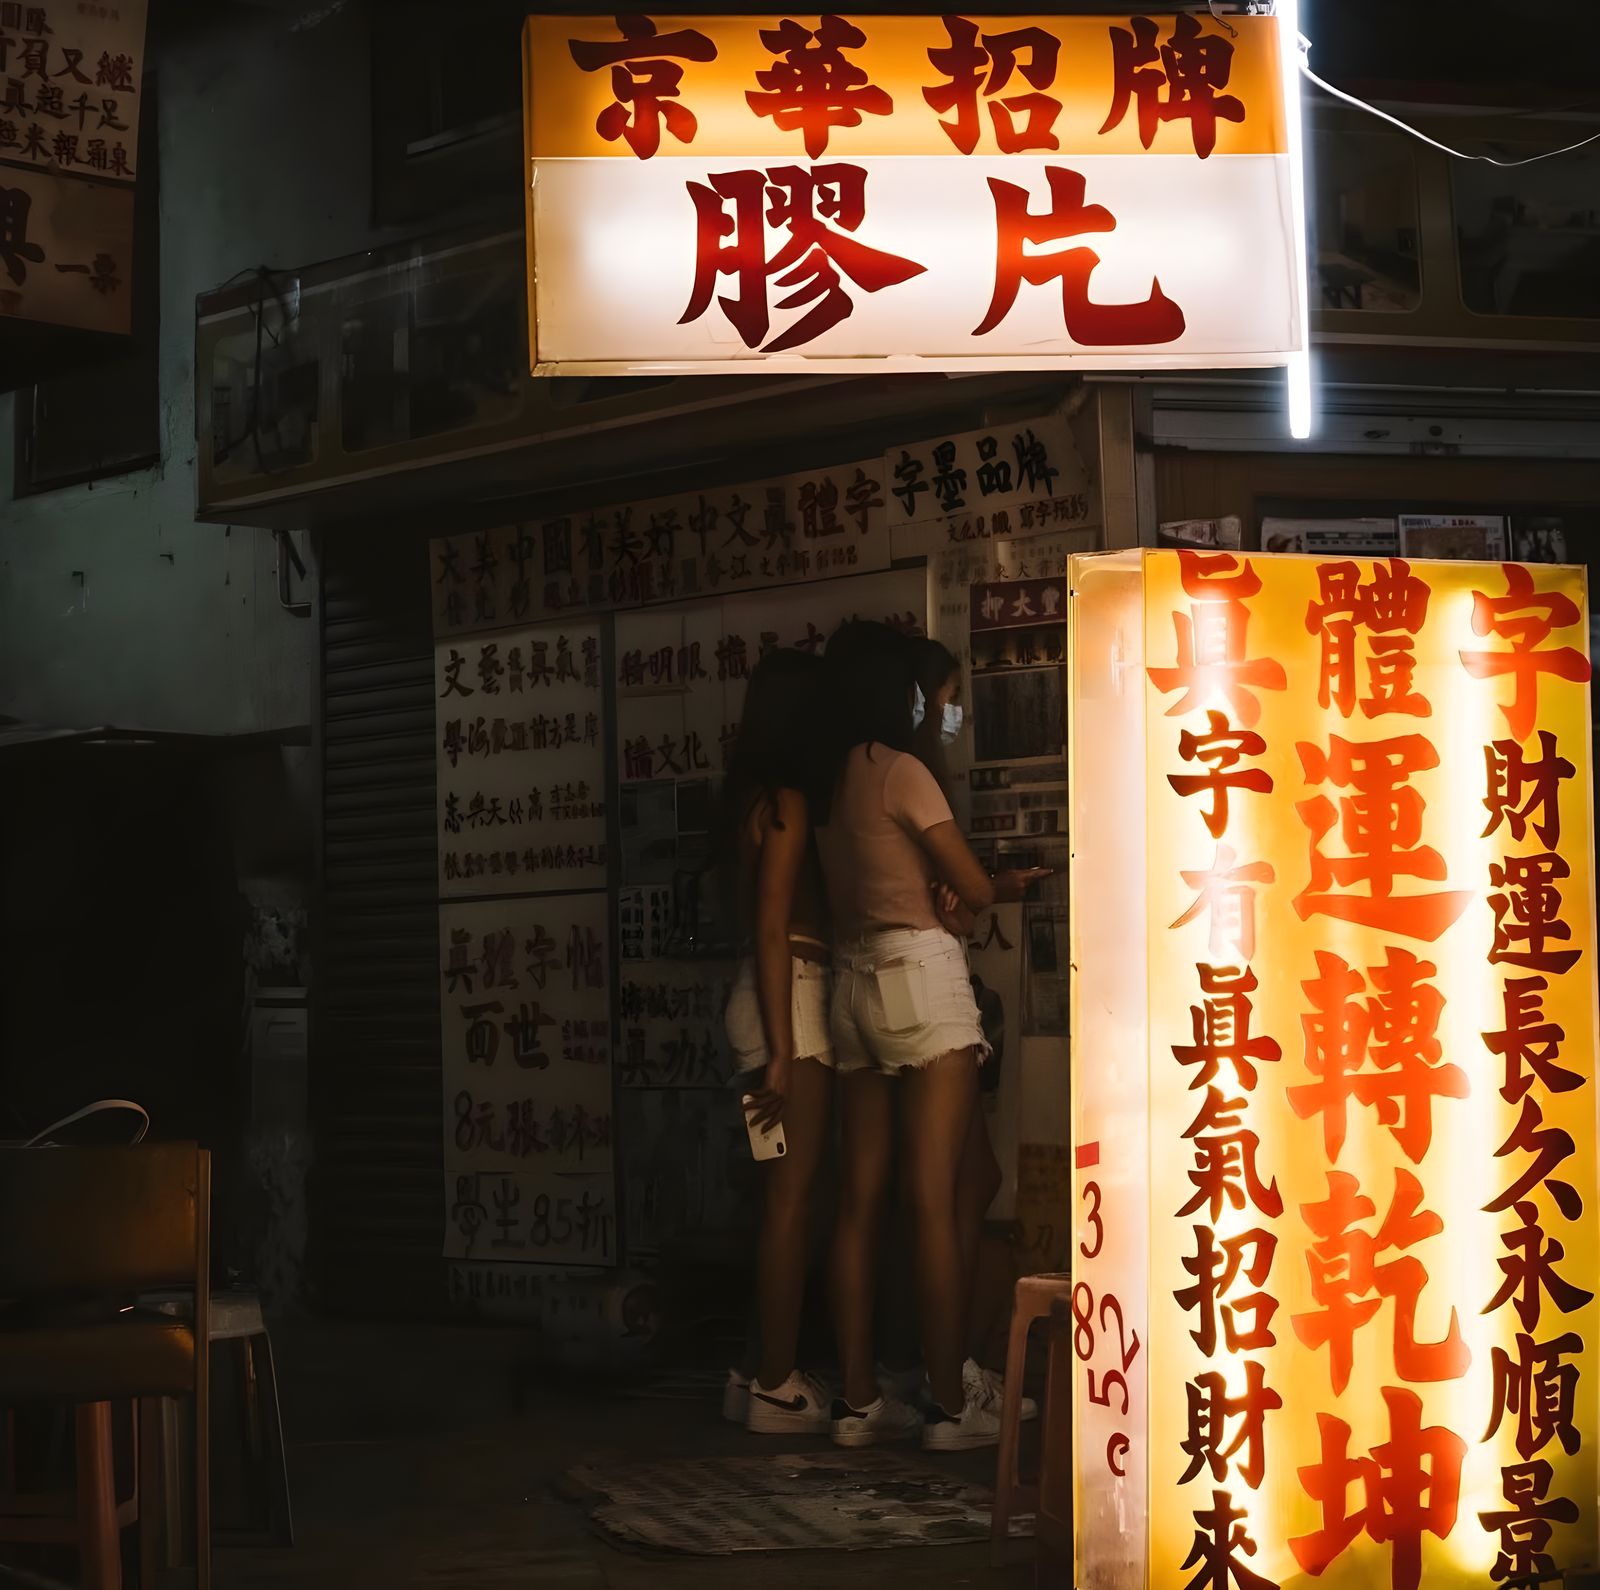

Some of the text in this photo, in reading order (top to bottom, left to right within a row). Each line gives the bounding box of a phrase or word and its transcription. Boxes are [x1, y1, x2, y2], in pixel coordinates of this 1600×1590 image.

[568, 15, 1246, 160] 京華招牌
[676, 162, 1187, 353] 膠片
